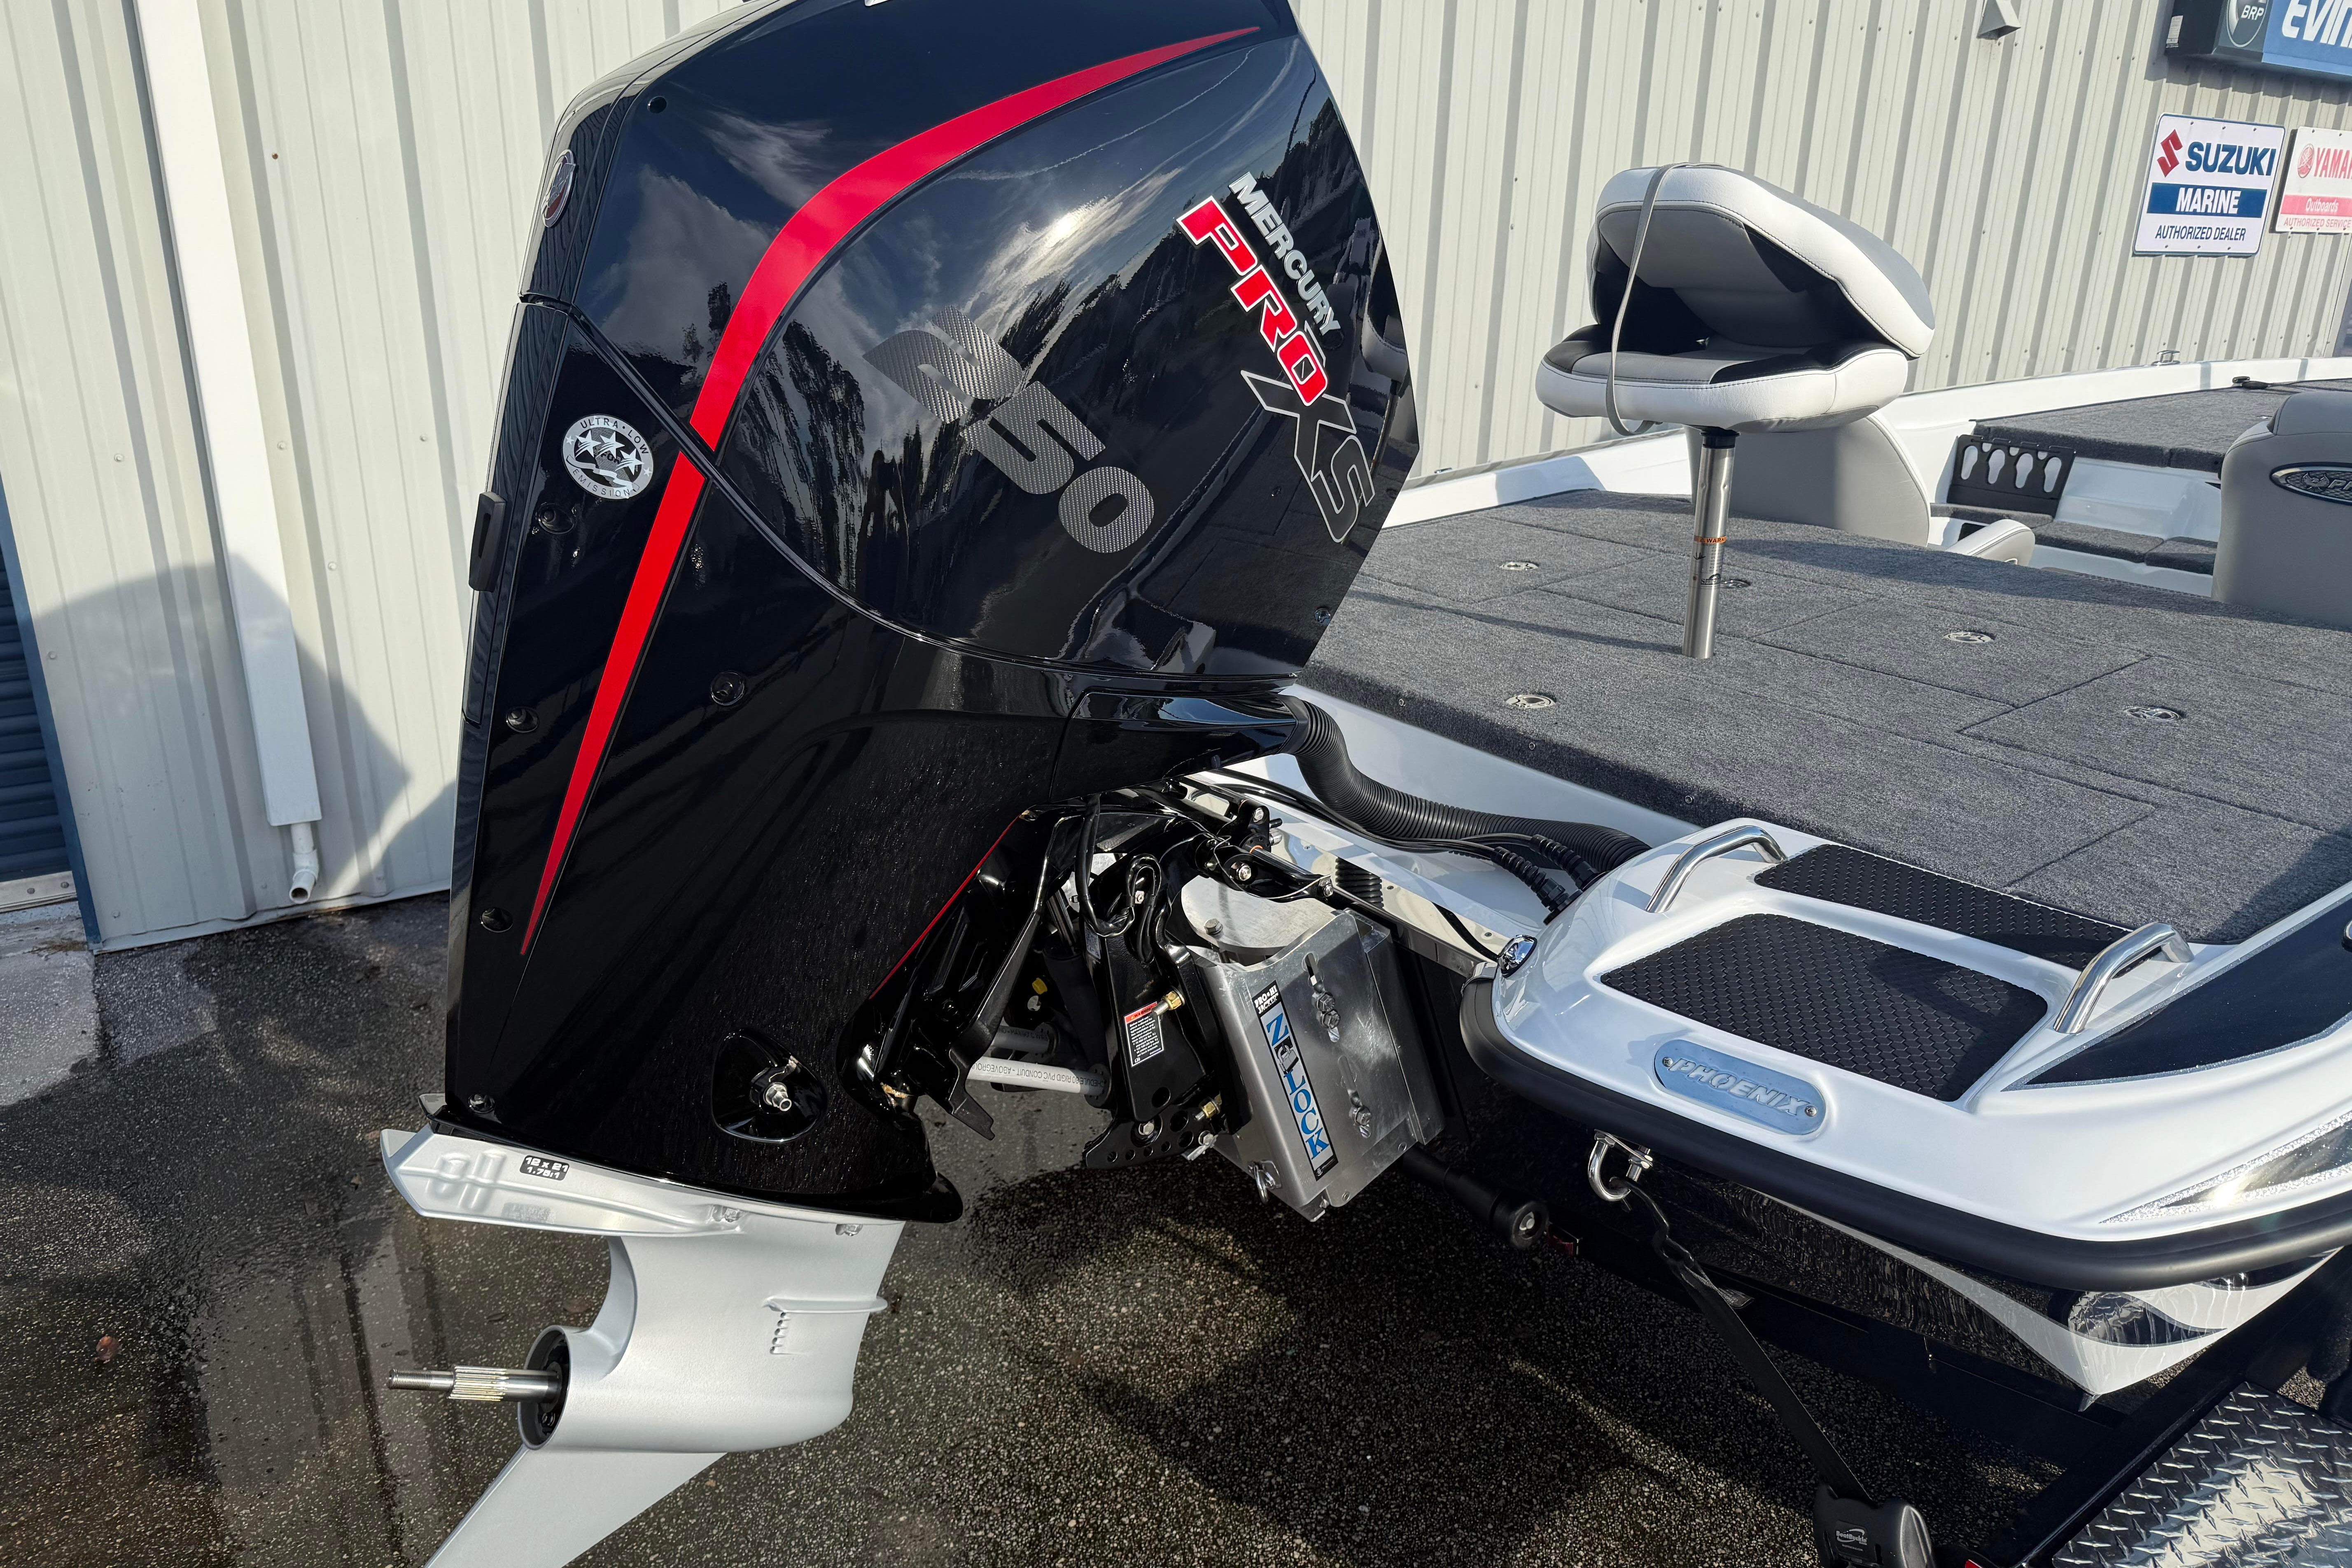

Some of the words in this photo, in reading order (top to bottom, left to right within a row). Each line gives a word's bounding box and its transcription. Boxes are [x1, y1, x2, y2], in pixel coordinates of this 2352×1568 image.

[2241, 5, 2264, 21] BRP
[2282, 0, 2352, 48] EVIN
[2185, 141, 2276, 176] SUZUKI
[2175, 187, 2241, 214] MARINE
[2305, 197, 2339, 212] Outboards
[2155, 225, 2212, 240] AUTHORIZED
[2213, 227, 2246, 241] DEALER
[2284, 217, 2325, 227] AUTHORIZED
[2326, 219, 2352, 228] SERVICE
[1228, 171, 1342, 336] MERCURY
[1176, 195, 1328, 407] PRO
[580, 418, 618, 429] ULTRA
[628, 429, 649, 454] LOW
[863, 305, 1155, 553] 250
[573, 469, 630, 497] EMISSION
[1016, 1068, 1043, 1078] CONDUIT
[1043, 1071, 1055, 1080] PVC
[1057, 1074, 1071, 1083] RIGID
[1668, 1058, 1810, 1115] PHOENIX
[1284, 1071, 1329, 1160] LOCK
[525, 1157, 541, 1167] 12
[551, 1162, 569, 1172] 21
